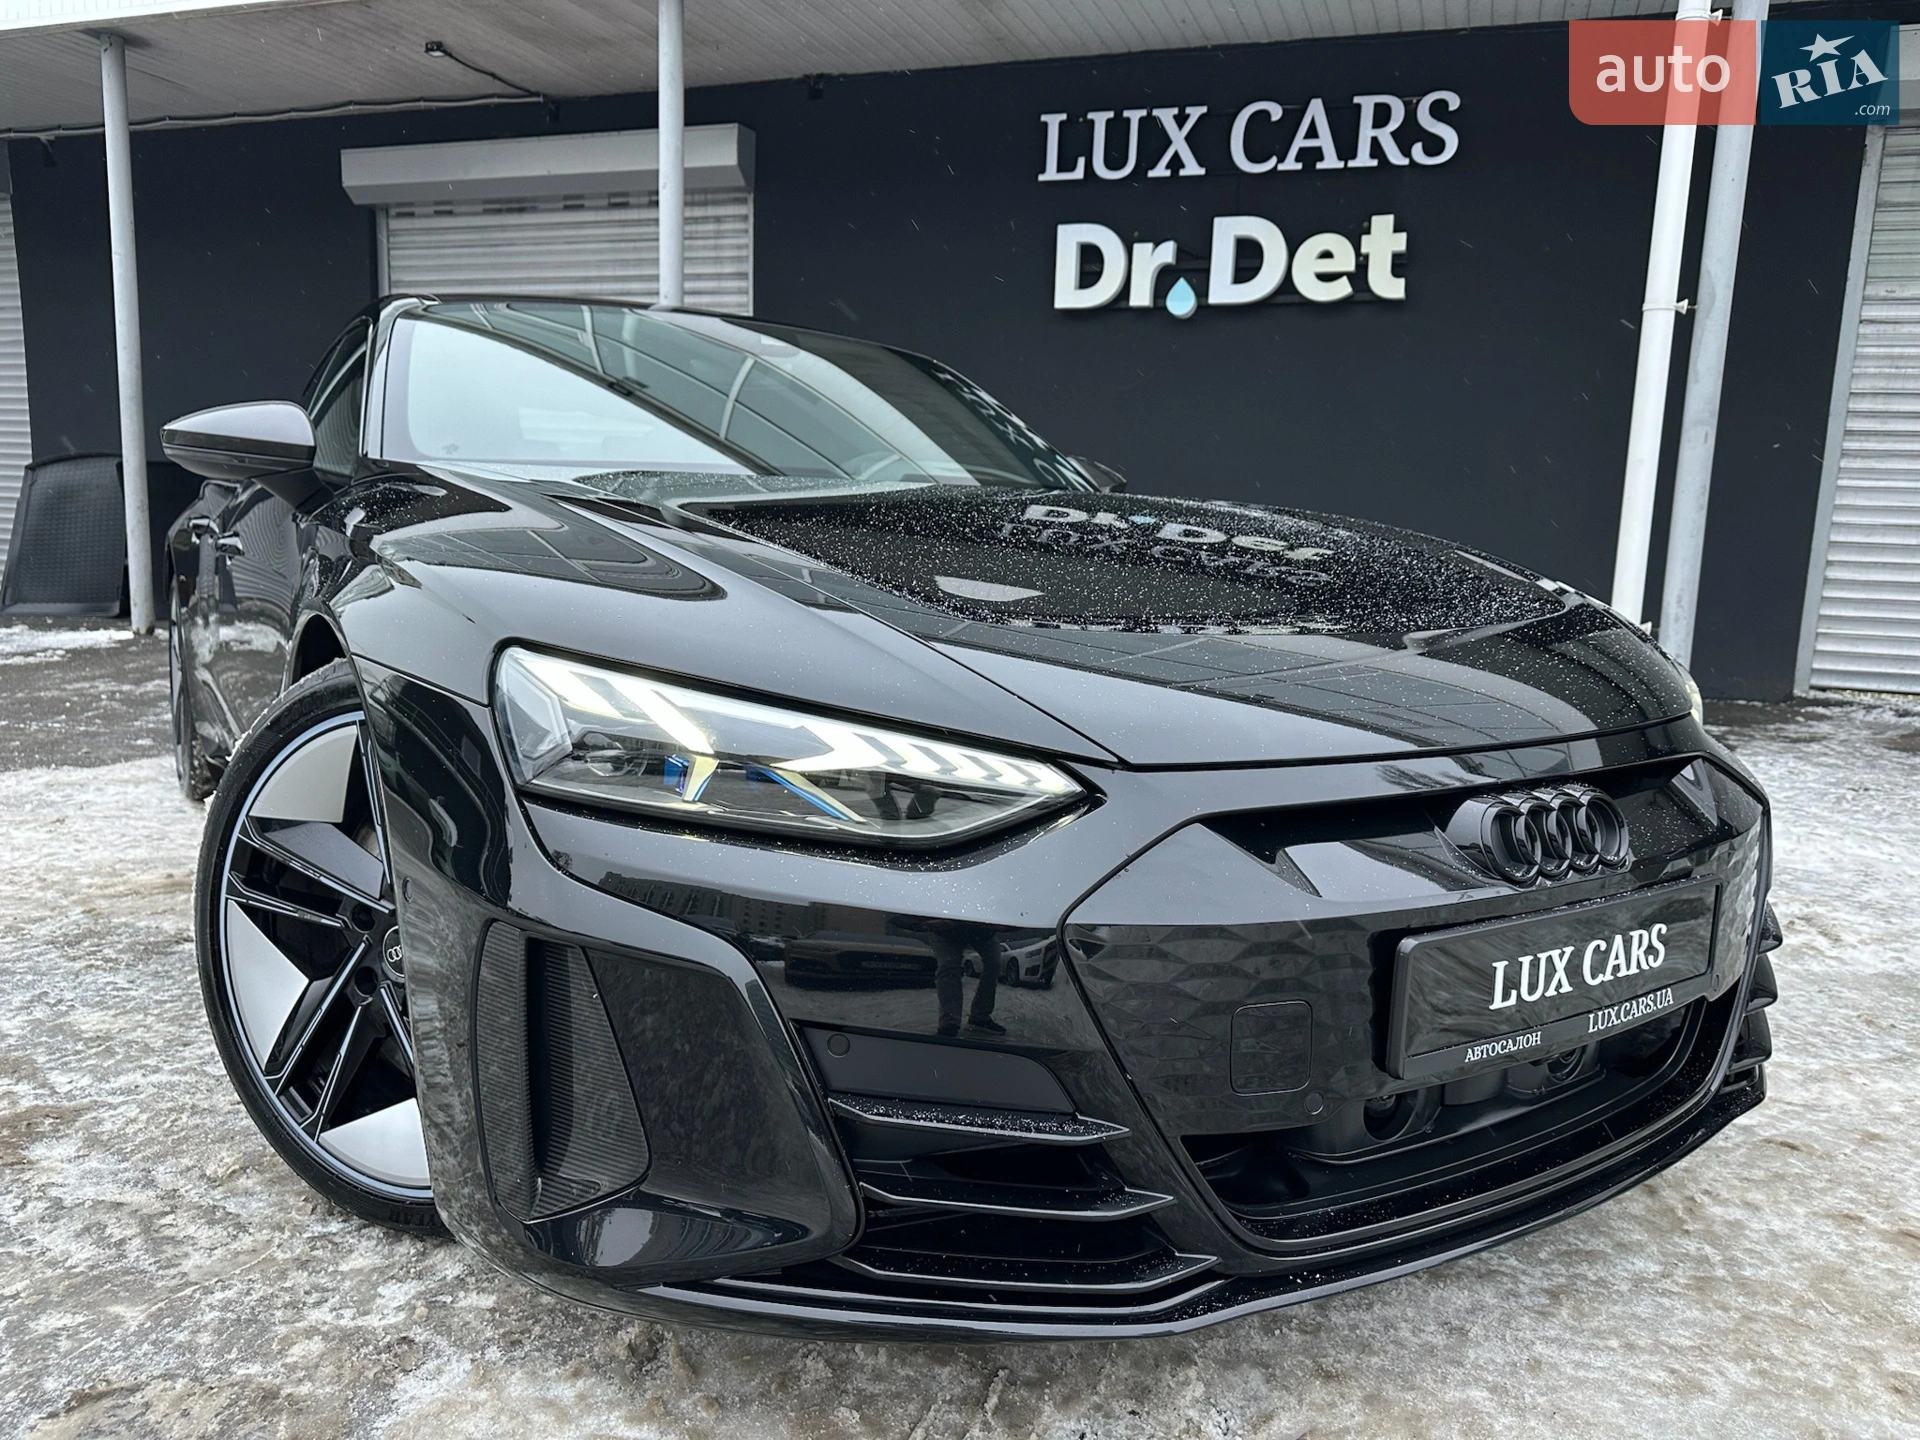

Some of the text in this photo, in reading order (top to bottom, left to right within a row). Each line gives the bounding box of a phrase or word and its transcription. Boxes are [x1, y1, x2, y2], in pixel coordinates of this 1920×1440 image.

[1037, 90, 1462, 182] LUX CARS
[1489, 922, 1668, 1010] LUX CARS
[1587, 987, 1675, 1033] LUX.CARS.UA
[1464, 1031, 1542, 1063] АВТОСАЛОН
